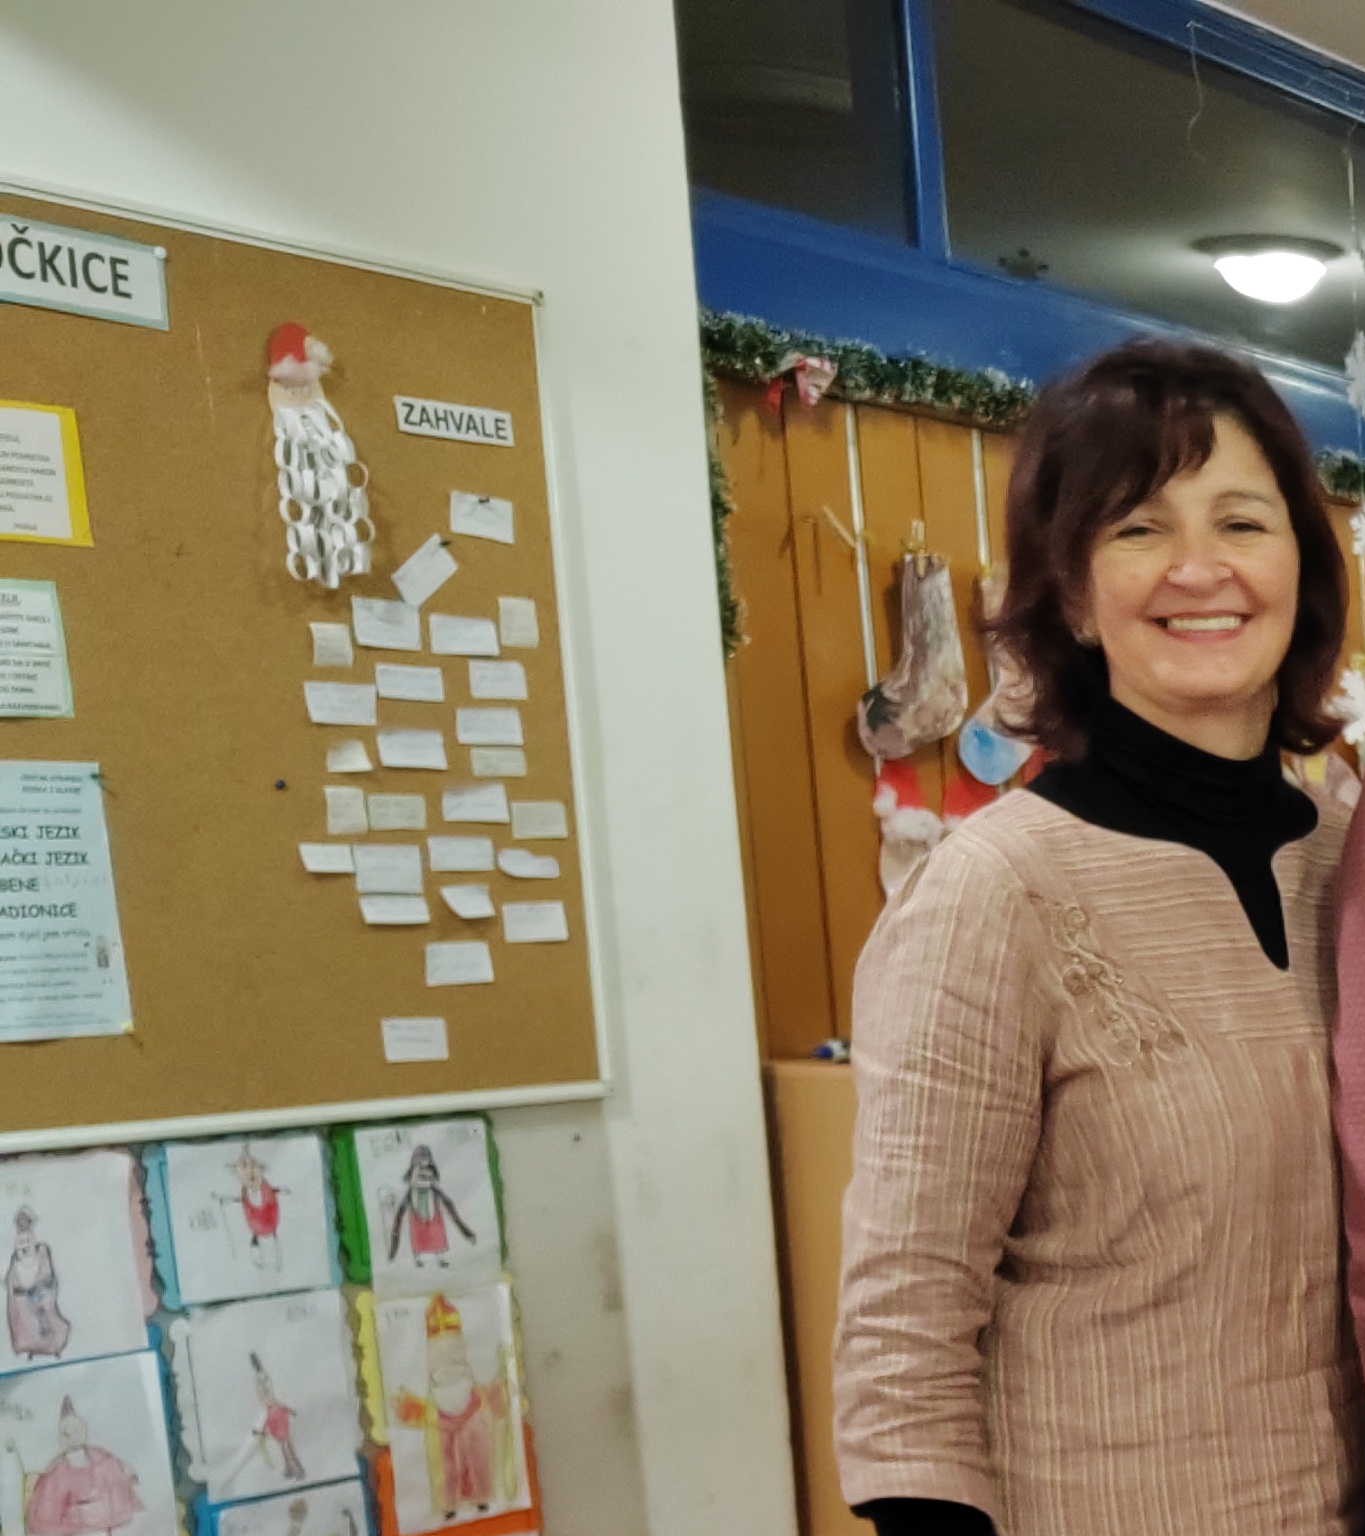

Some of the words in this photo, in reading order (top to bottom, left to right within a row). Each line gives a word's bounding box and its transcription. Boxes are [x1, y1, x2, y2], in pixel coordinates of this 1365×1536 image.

[0, 222, 132, 299] ČKICE
[401, 402, 508, 440] ZAHVALE
[36, 825, 81, 840] JEZIK
[45, 850, 88, 867] JEZIK
